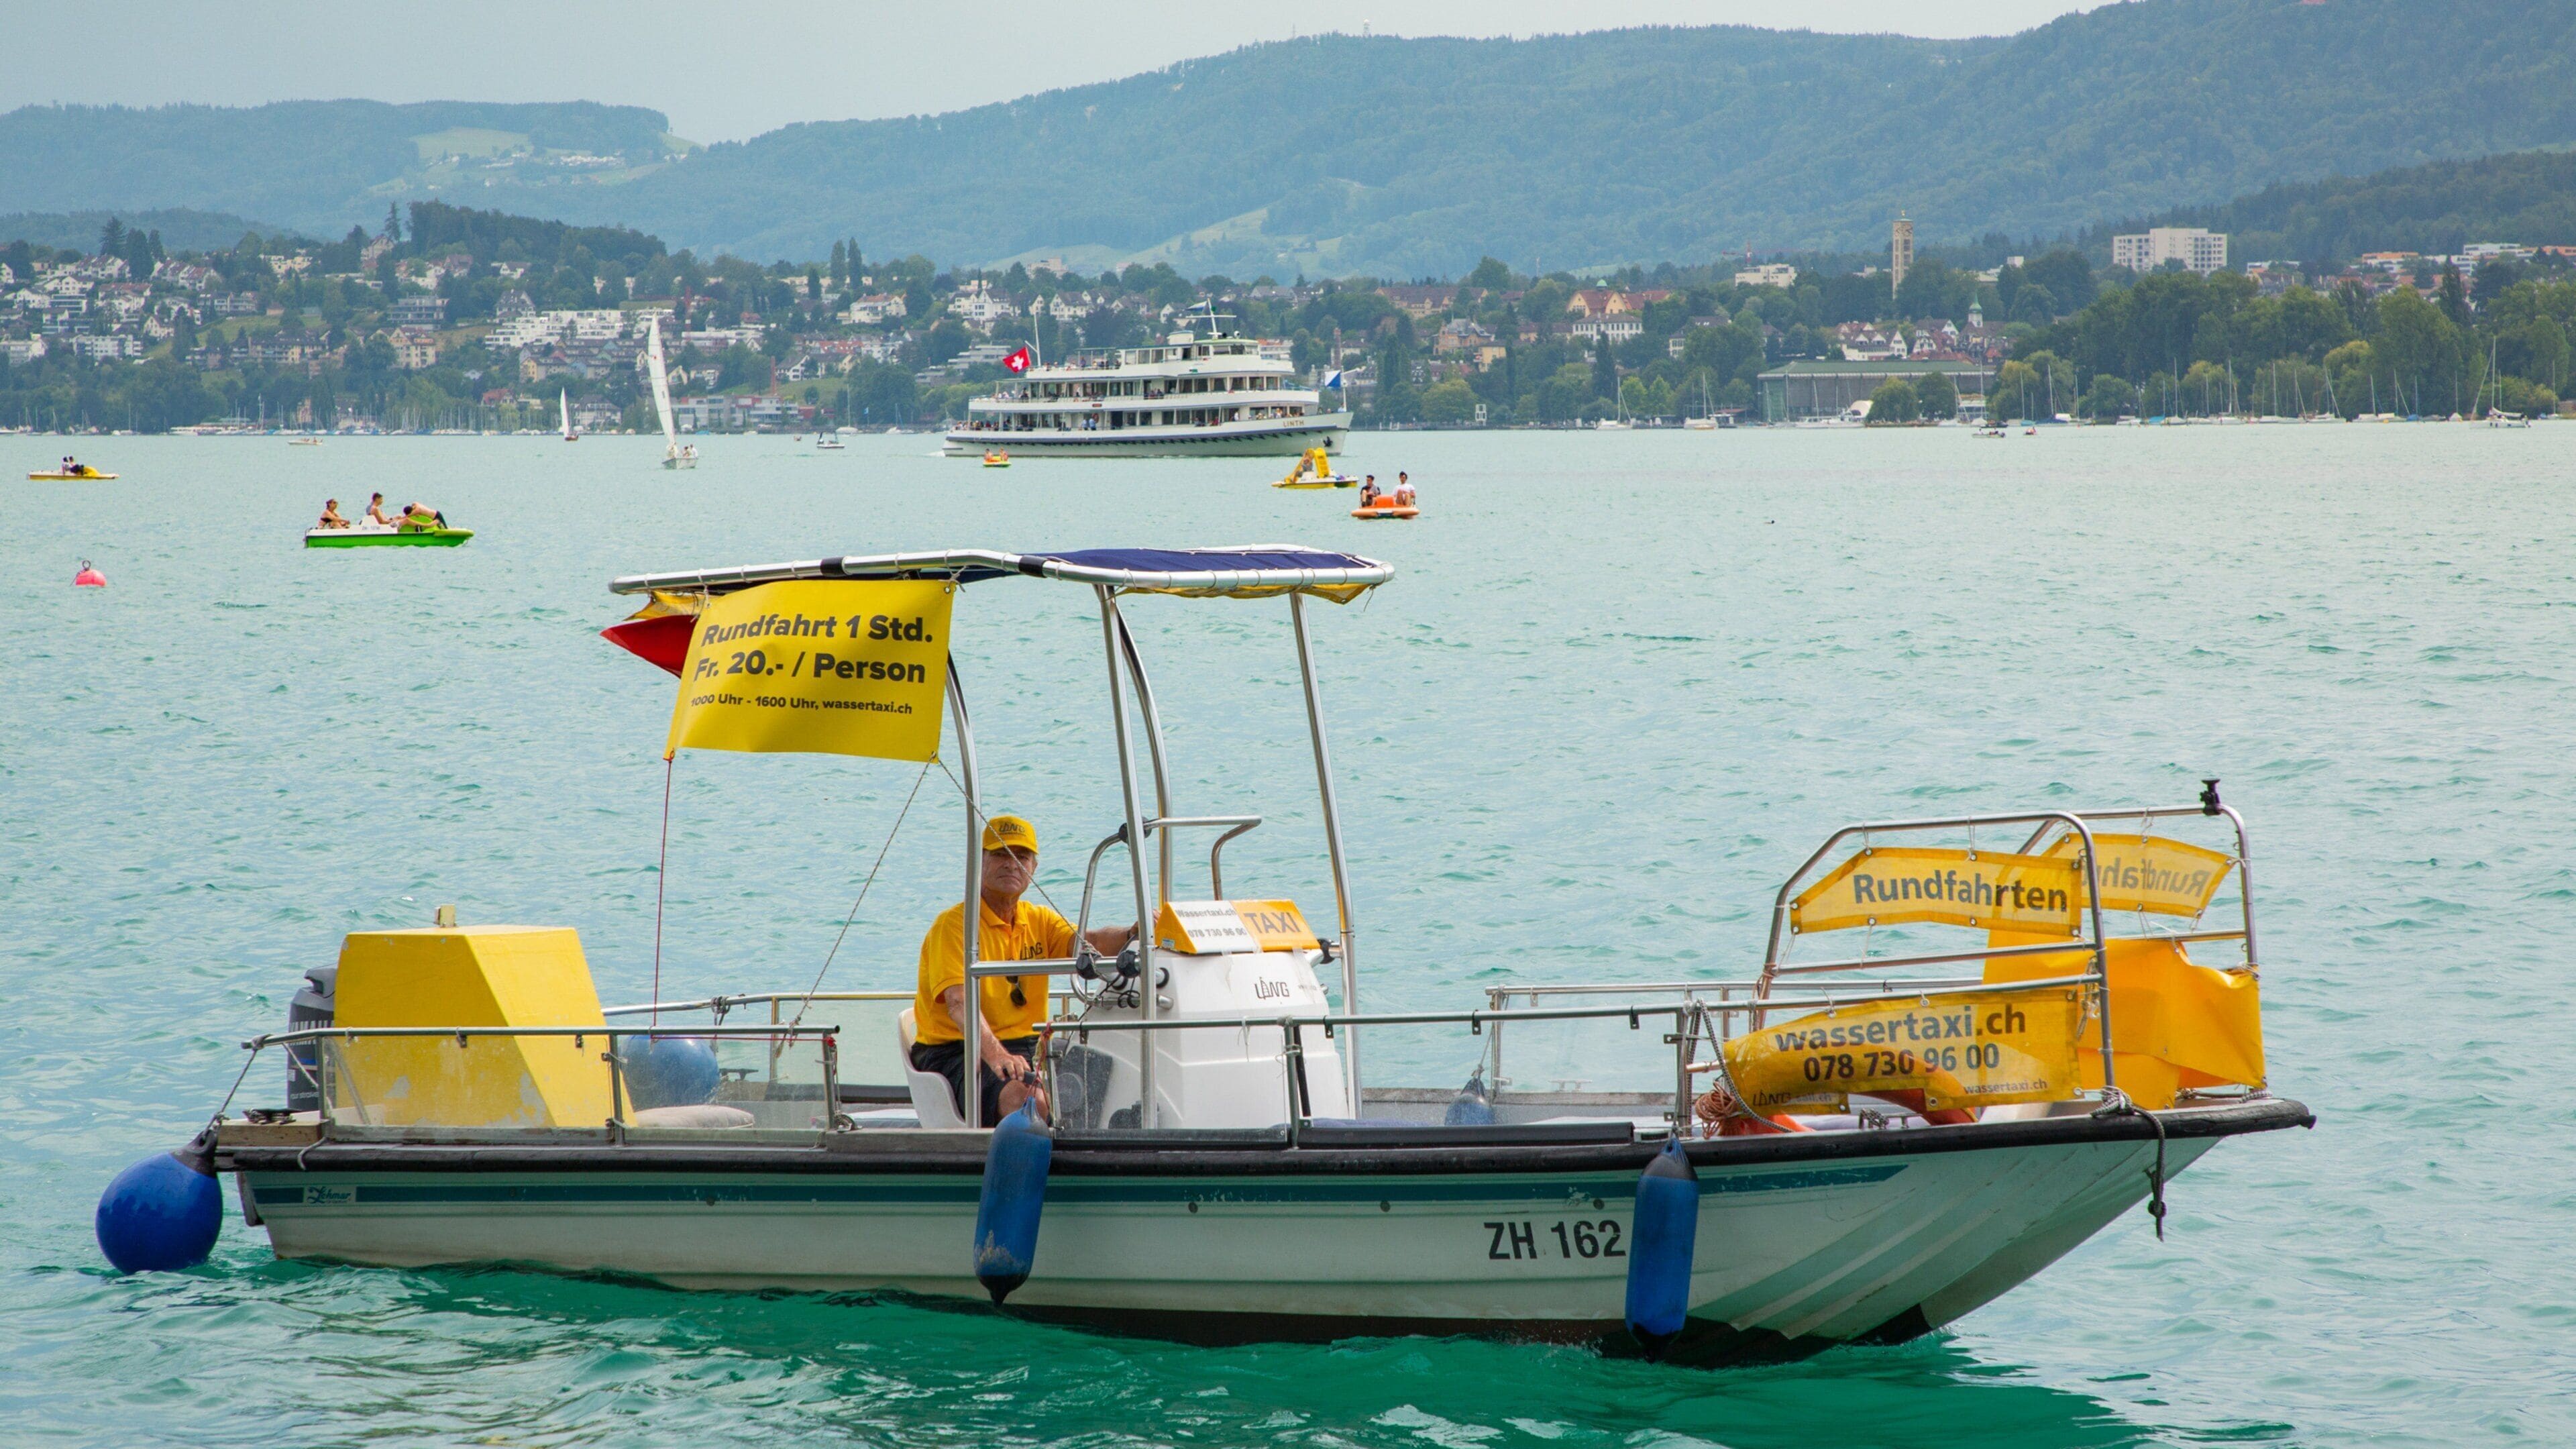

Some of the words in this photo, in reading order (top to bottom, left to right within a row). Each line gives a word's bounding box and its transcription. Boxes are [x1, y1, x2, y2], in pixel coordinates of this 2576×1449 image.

[701, 614, 837, 647] Rundfahrt
[845, 614, 861, 638] 1
[868, 614, 932, 643] Std.
[694, 657, 719, 682] Fr.
[727, 649, 784, 676] 20.-
[791, 651, 806, 678] /
[813, 653, 925, 684] Person
[691, 694, 715, 707] 1000
[718, 693, 744, 706] Uhr
[755, 696, 787, 708] 1600
[790, 697, 819, 710] Uhr,
[822, 699, 912, 714] wassertaxi.ch
[1853, 869, 2068, 912] Rundfahrten
[1176, 908, 1237, 919] Wassertaxi.ch
[1244, 912, 1301, 934] TAXI
[1187, 928, 1205, 938] 078
[1207, 928, 1222, 937] 730
[1224, 928, 1235, 936] 96
[1775, 1004, 2026, 1052] wassertaxi.ch
[1803, 1053, 1855, 1082] 078
[1864, 1051, 1915, 1077] 730
[1923, 1046, 1957, 1073] 96
[1966, 1042, 2000, 1070] 00
[1964, 1078, 2048, 1094] wassertaxi.ch
[1483, 1222, 1538, 1259] ZH
[1550, 1220, 1626, 1259] 162
